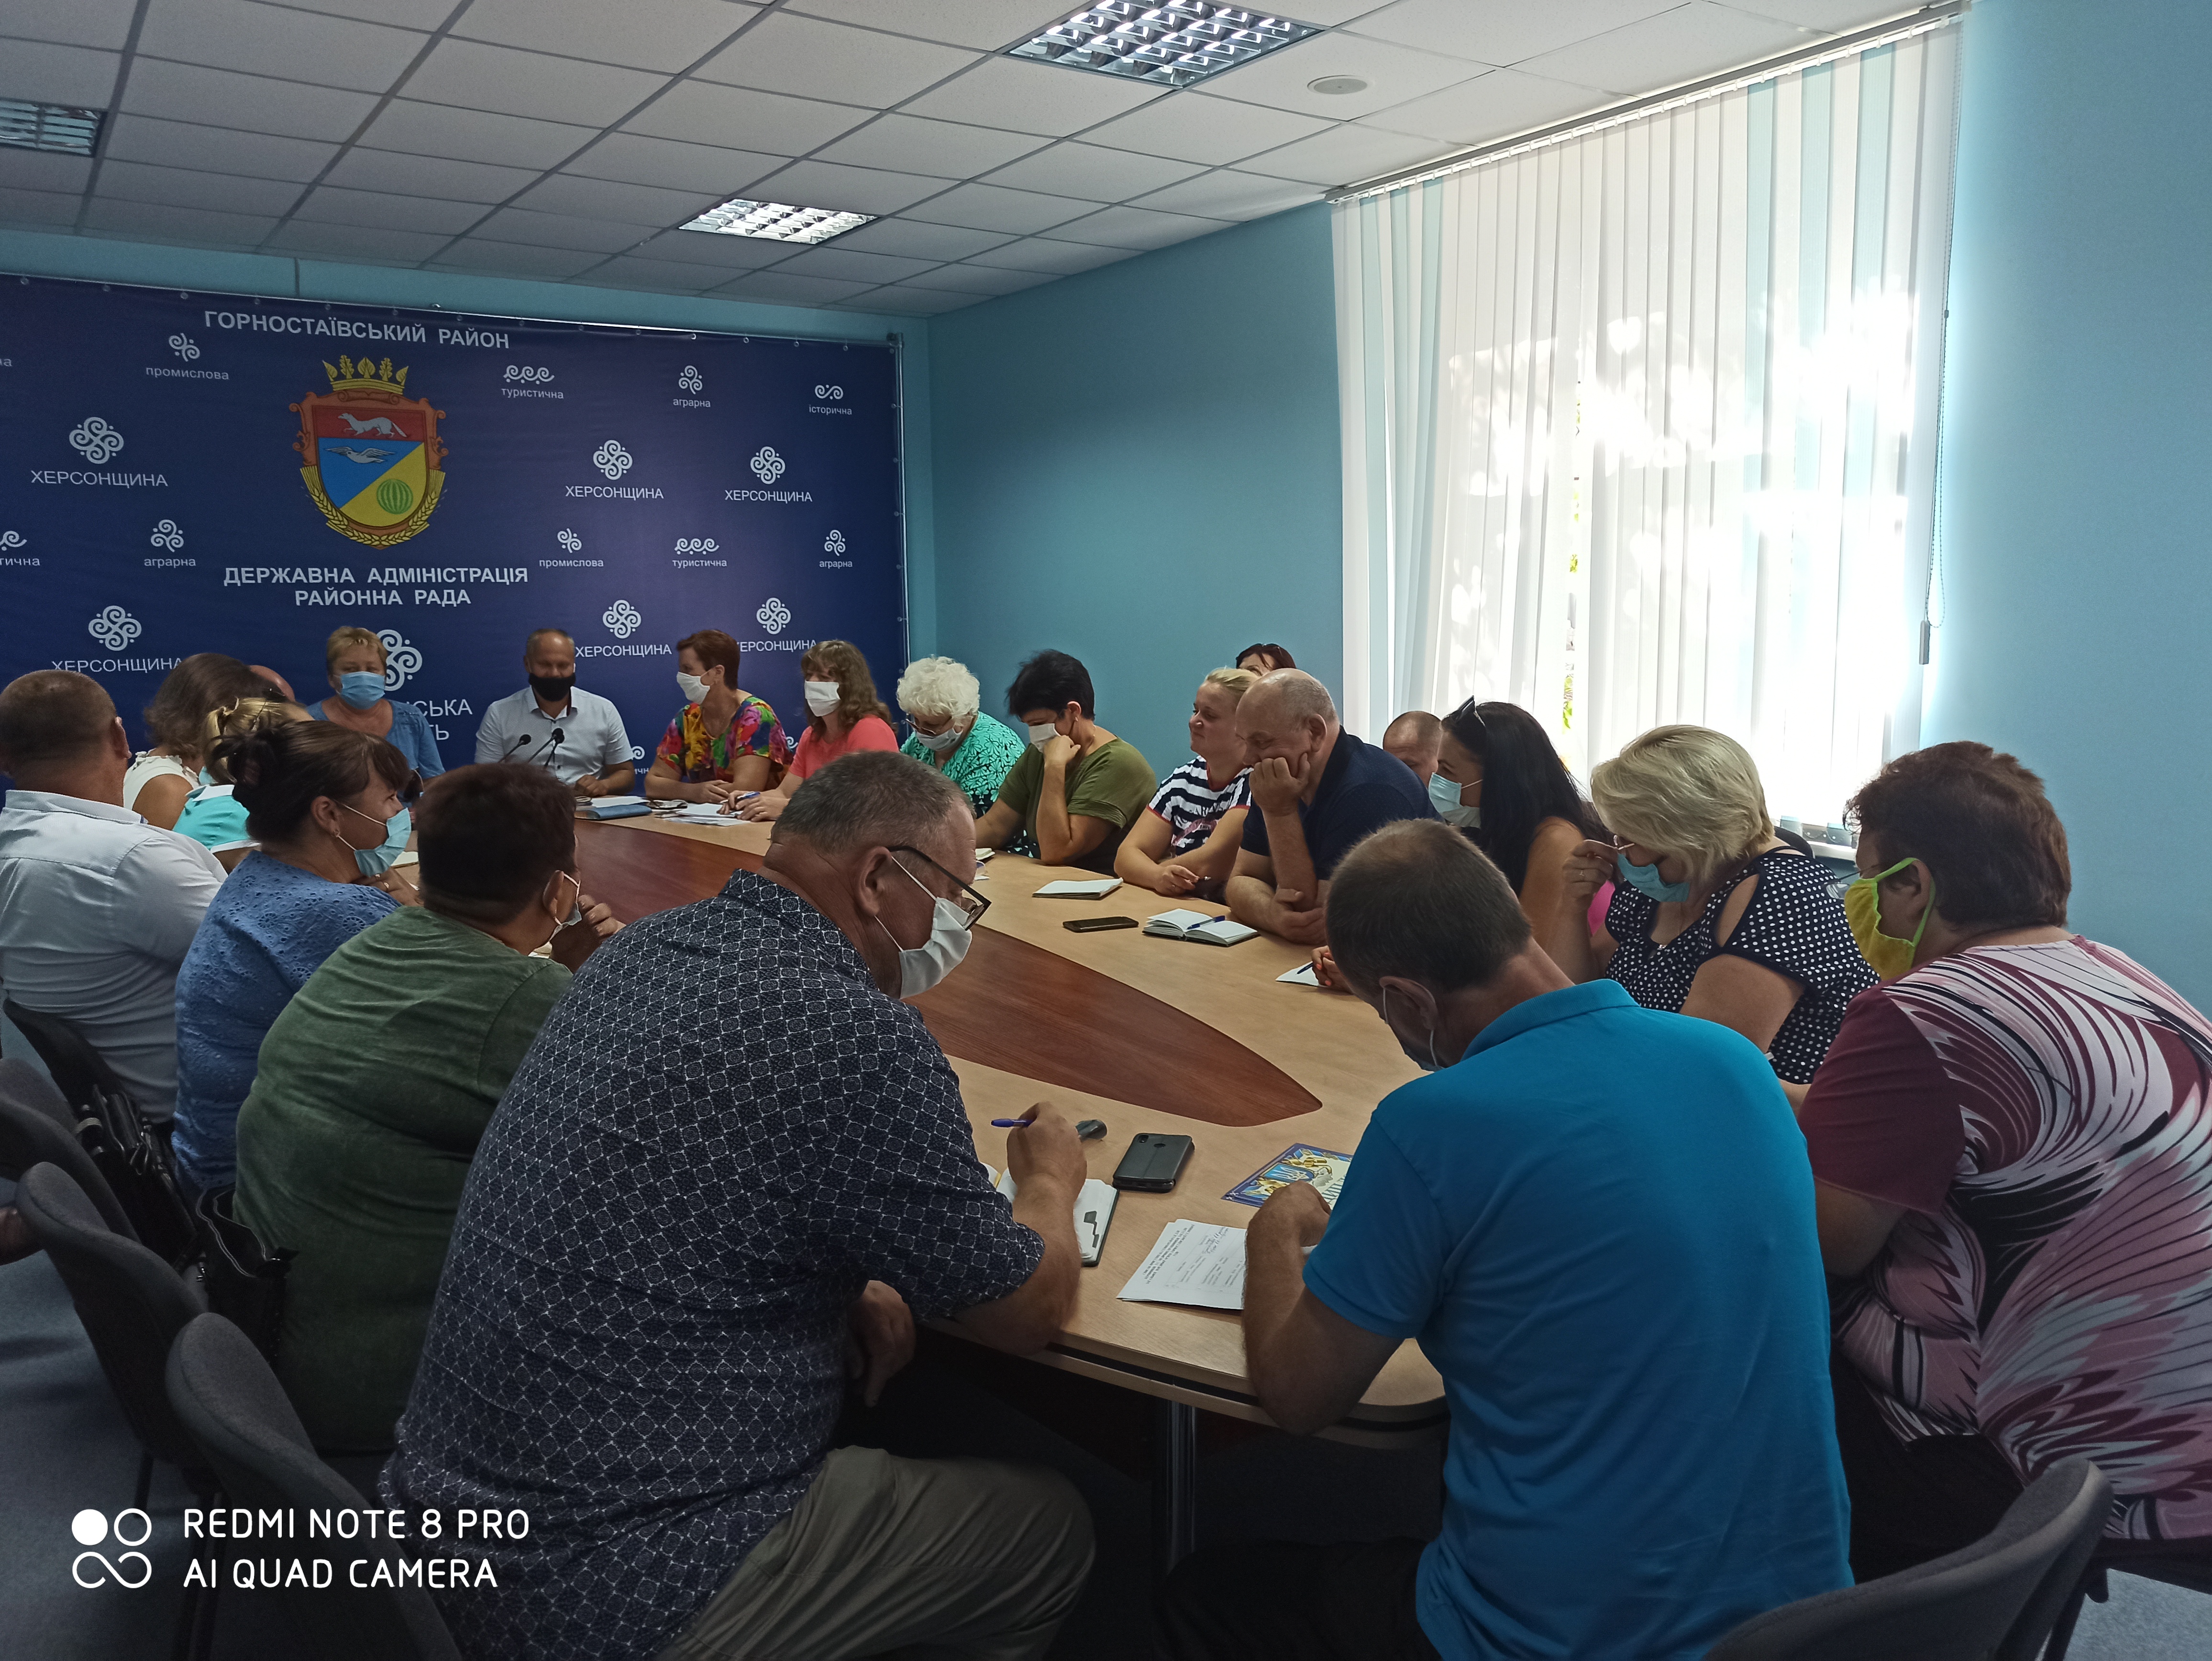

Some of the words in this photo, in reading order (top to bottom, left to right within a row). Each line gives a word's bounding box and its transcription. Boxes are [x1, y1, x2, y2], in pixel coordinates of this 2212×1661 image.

[204, 311, 426, 343] ГОРНОСТАЇВСЬКИЙ
[439, 327, 509, 349] РАЙОН
[146, 367, 229, 380] промислова
[501, 388, 564, 399] туристична
[673, 399, 711, 409] аграрна
[809, 405, 852, 415] історична
[31, 470, 168, 488] ХЕРСОНЩИНА
[565, 486, 664, 501] ХЕРСОНЩИНА
[725, 490, 813, 504] ХЕРСОНЩИНА
[144, 558, 196, 569] аграрна
[539, 560, 604, 569] промислова
[672, 560, 727, 569] туристична
[819, 561, 852, 569] аграрна
[223, 567, 355, 587] ДЕРЖАВНА
[367, 567, 528, 586] АДМІНІСТРАЦІЯ
[295, 587, 403, 606] РАЙОННА
[415, 589, 471, 607] РАДА
[575, 644, 672, 658] ХЕРСОНЩИНА
[736, 640, 816, 653] ЕРСОНЩИНА
